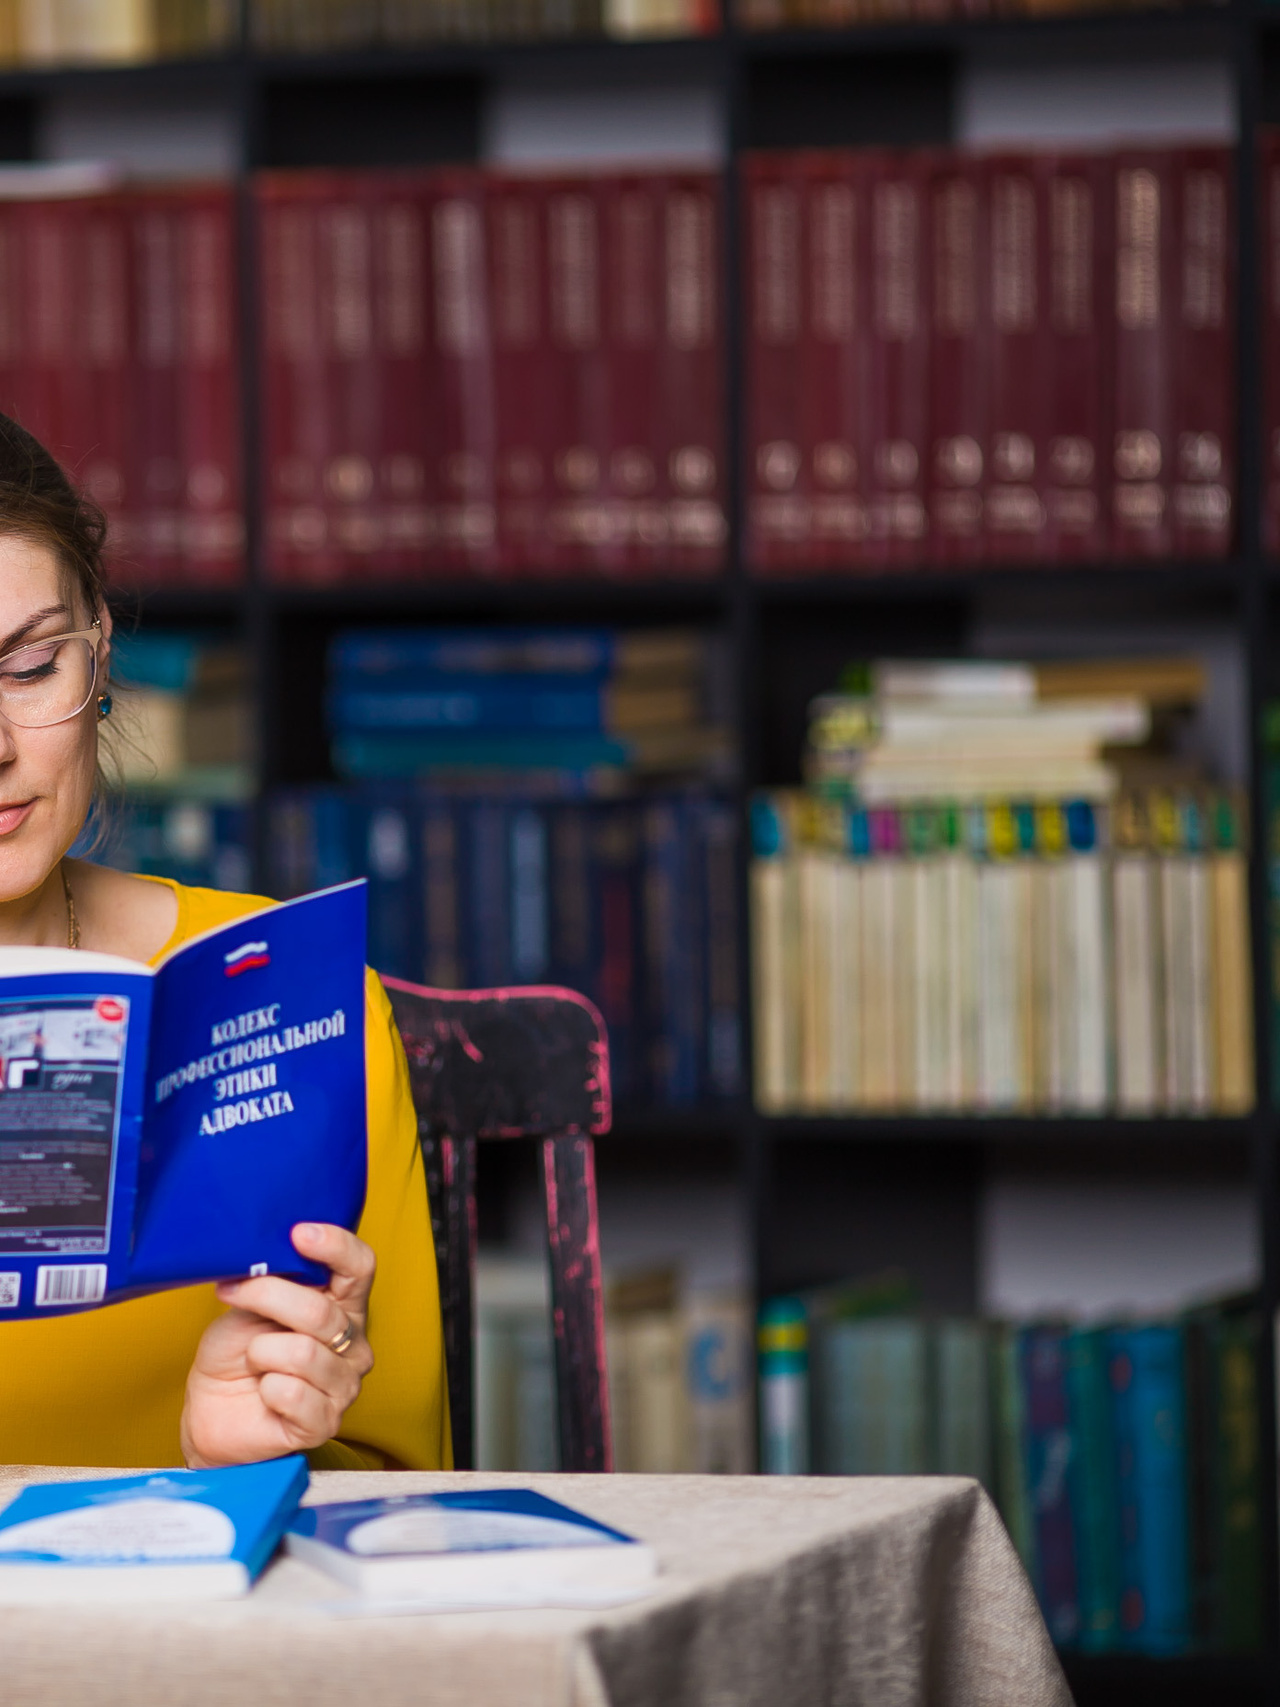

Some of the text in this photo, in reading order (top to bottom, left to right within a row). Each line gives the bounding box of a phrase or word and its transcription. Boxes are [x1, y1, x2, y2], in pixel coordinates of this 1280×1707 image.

[211, 1003, 280, 1046] КОДЕКС
[156, 1009, 345, 1102] ПРОФЕССИОНАЛЬНОЙ
[213, 1063, 277, 1101] ЭТИКИ
[199, 1091, 294, 1136] АДВОКАТА
